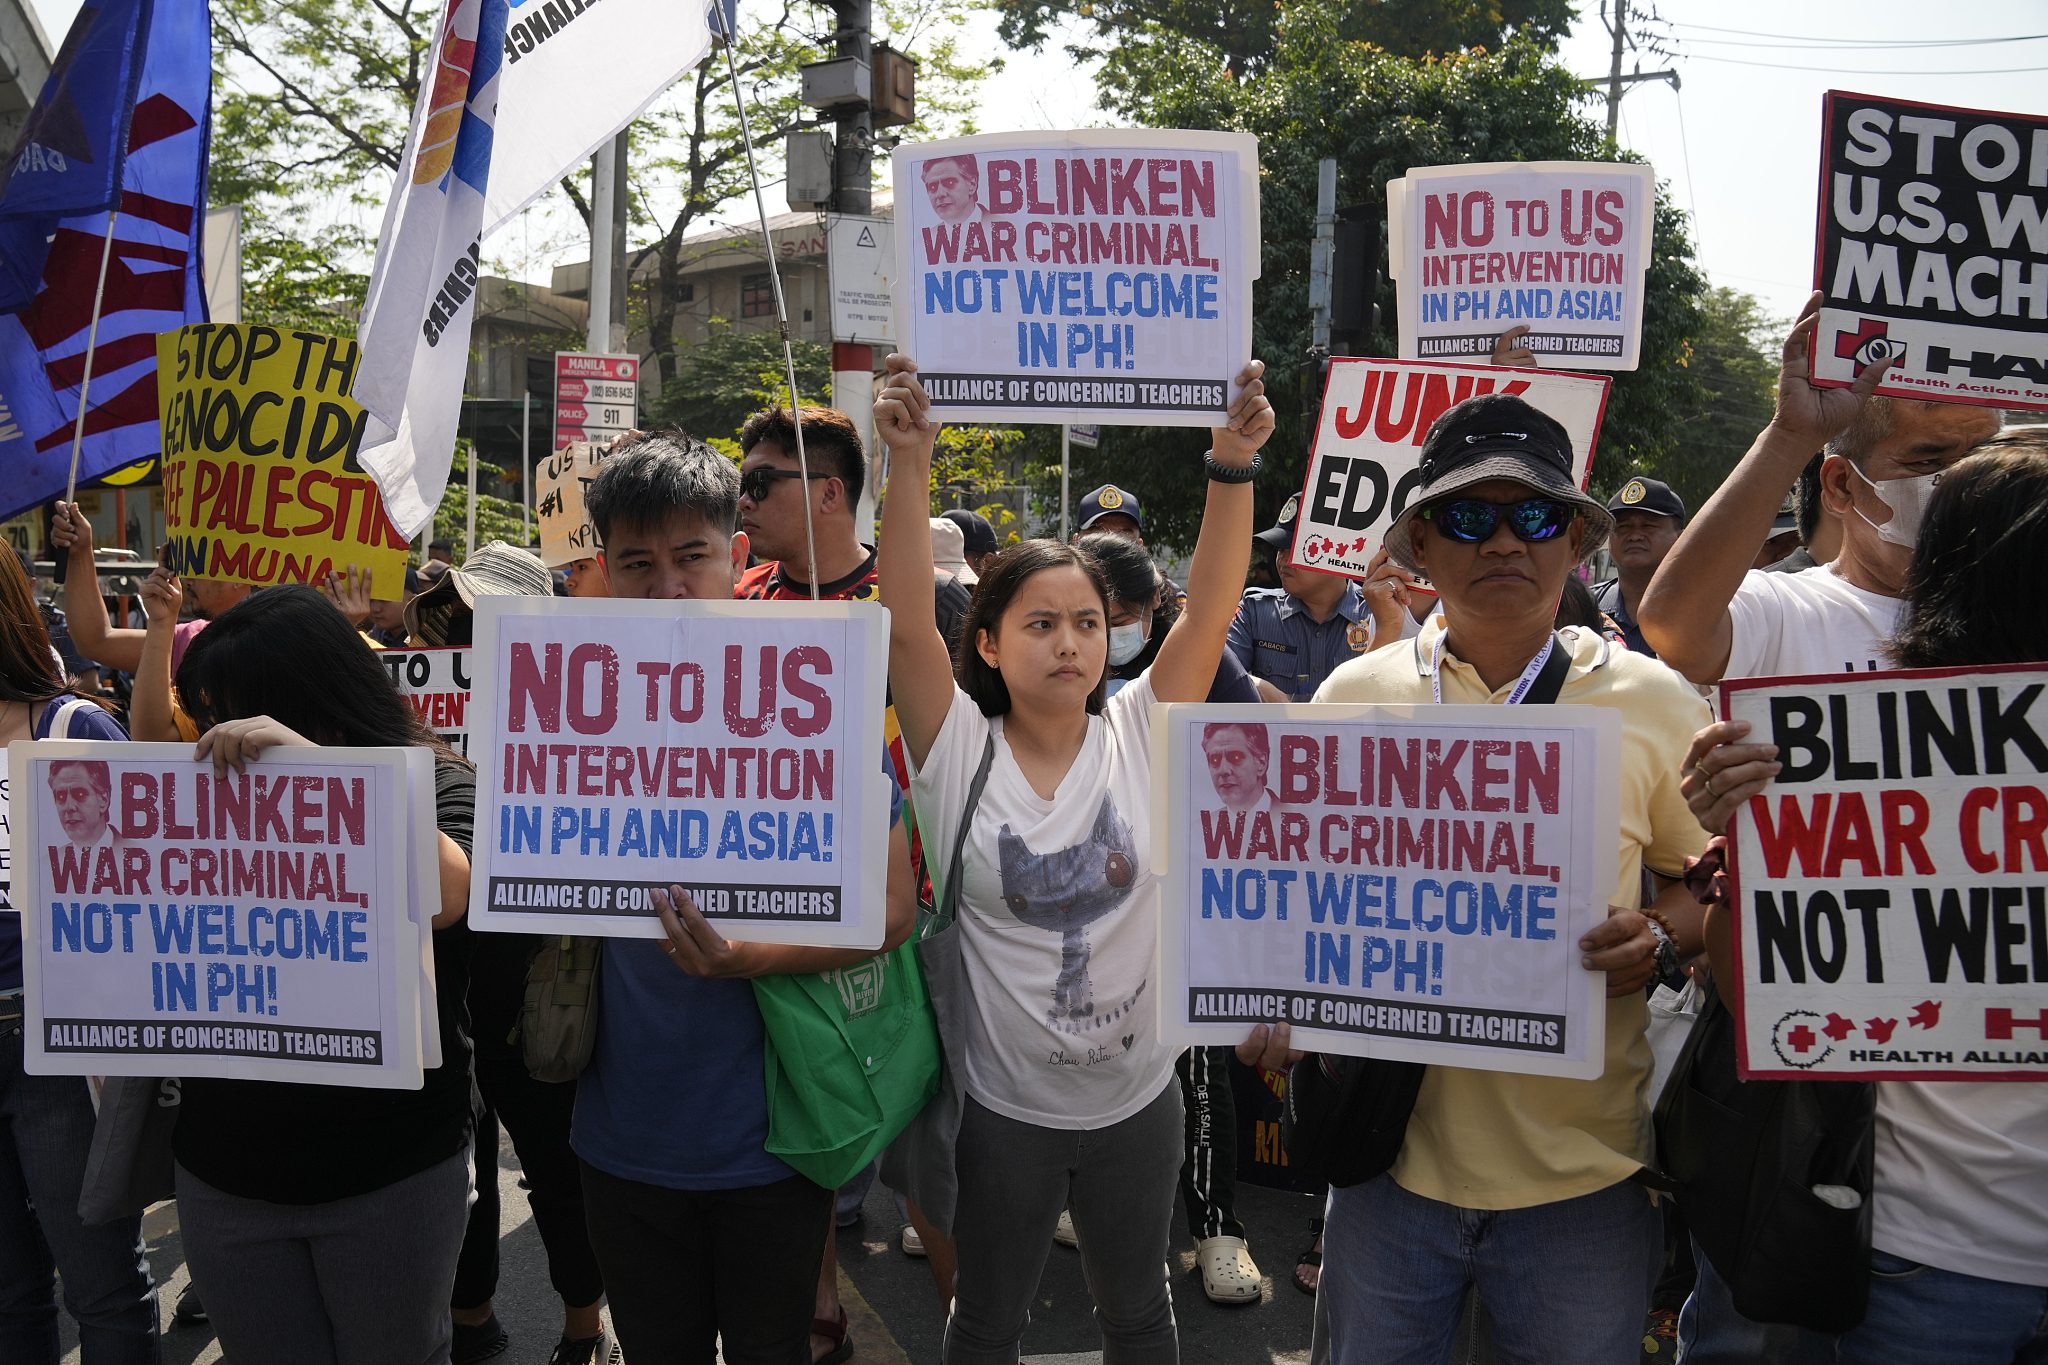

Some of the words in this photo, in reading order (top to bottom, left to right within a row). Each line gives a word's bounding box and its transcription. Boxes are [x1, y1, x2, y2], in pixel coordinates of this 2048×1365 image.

[987, 158, 1215, 218] BLINKEN
[1834, 171, 1968, 244] U.S.
[1425, 190, 1494, 250] NO
[1506, 200, 1549, 237] TO
[1561, 189, 1624, 246] US
[922, 222, 1017, 266] WAR
[1025, 222, 1219, 272] CRIMINAL,
[1423, 252, 1623, 287] INTERVENTION
[840, 290, 861, 298] TRAFFIC
[924, 270, 1008, 315] NOT
[1015, 271, 1219, 320] WELCOME
[1831, 237, 2048, 320] MACH
[1422, 293, 1448, 322] IN
[1453, 290, 1490, 321] PH
[1495, 289, 1552, 319] AND
[1556, 289, 1622, 322] ASIA!
[177, 323, 281, 385] STOP
[292, 331, 361, 397] TH
[568, 358, 606, 371] MANILA
[1019, 322, 1056, 367] IN
[1068, 323, 1135, 370] PH!
[1421, 337, 1475, 354] ALLIANCE
[1477, 337, 1492, 352] OF
[1495, 337, 1563, 351] NCERNED
[1565, 337, 1620, 353] TEACHERS
[923, 379, 1004, 402] ALLIANCE
[1008, 381, 1029, 402] OF
[1033, 381, 1135, 405] CONCERNED
[1140, 384, 1223, 406] TEACHERS
[1890, 373, 1950, 389] Health
[1956, 383, 2019, 396] Action
[558, 409, 585, 419] POLICE:
[604, 409, 619, 424] 911
[548, 446, 573, 480] US
[190, 459, 410, 551] PALESTIN
[540, 487, 563, 517] #1
[209, 539, 347, 587] MUNA
[1328, 558, 1365, 571] HEALTH
[383, 653, 430, 687] TO
[508, 642, 620, 735] NO
[636, 661, 704, 723] TO
[723, 645, 833, 738] US
[400, 692, 470, 727] VEN
[1770, 684, 2048, 783] BLINK
[503, 743, 834, 800] INTERVENTION
[1280, 735, 1560, 815] BLINKEN
[121, 772, 366, 847] BLINKEN
[500, 805, 542, 855] IN
[551, 806, 610, 858] PH
[618, 809, 710, 860] AND
[716, 810, 833, 863] ASIA!
[1749, 791, 1936, 878] WAR
[1201, 810, 1310, 863] WAR
[1320, 813, 1561, 883] CRIMINAL,
[48, 846, 151, 896] WAR
[160, 847, 369, 908] CRIMINAL,
[494, 883, 583, 909] ALLIANCE
[587, 885, 611, 909] OF
[615, 886, 730, 913] CONNED
[734, 890, 835, 915] TEACHERS
[1202, 868, 1298, 921] NOT
[1306, 871, 1558, 941] WELCOME
[51, 902, 141, 953] NOT
[150, 904, 368, 963] WELCOME
[1755, 889, 1890, 984] NOT
[152, 962, 196, 1012] IN
[206, 963, 278, 1016] PH!
[1305, 932, 1350, 987] IN
[1362, 936, 1443, 996] PH!
[853, 972, 871, 1008] 7
[50, 1024, 138, 1047] ALLIANCE
[143, 1026, 166, 1047] OF
[170, 1026, 279, 1053] CONCERNED
[283, 1031, 377, 1059] TEACHERS
[1195, 993, 1286, 1019] ALLIANCE
[1292, 1001, 1315, 1021] OF
[1320, 1003, 1442, 1035] CONCERNED
[1448, 1013, 1558, 1046] TEACHERS
[1850, 1049, 1953, 1063] HEALTH
